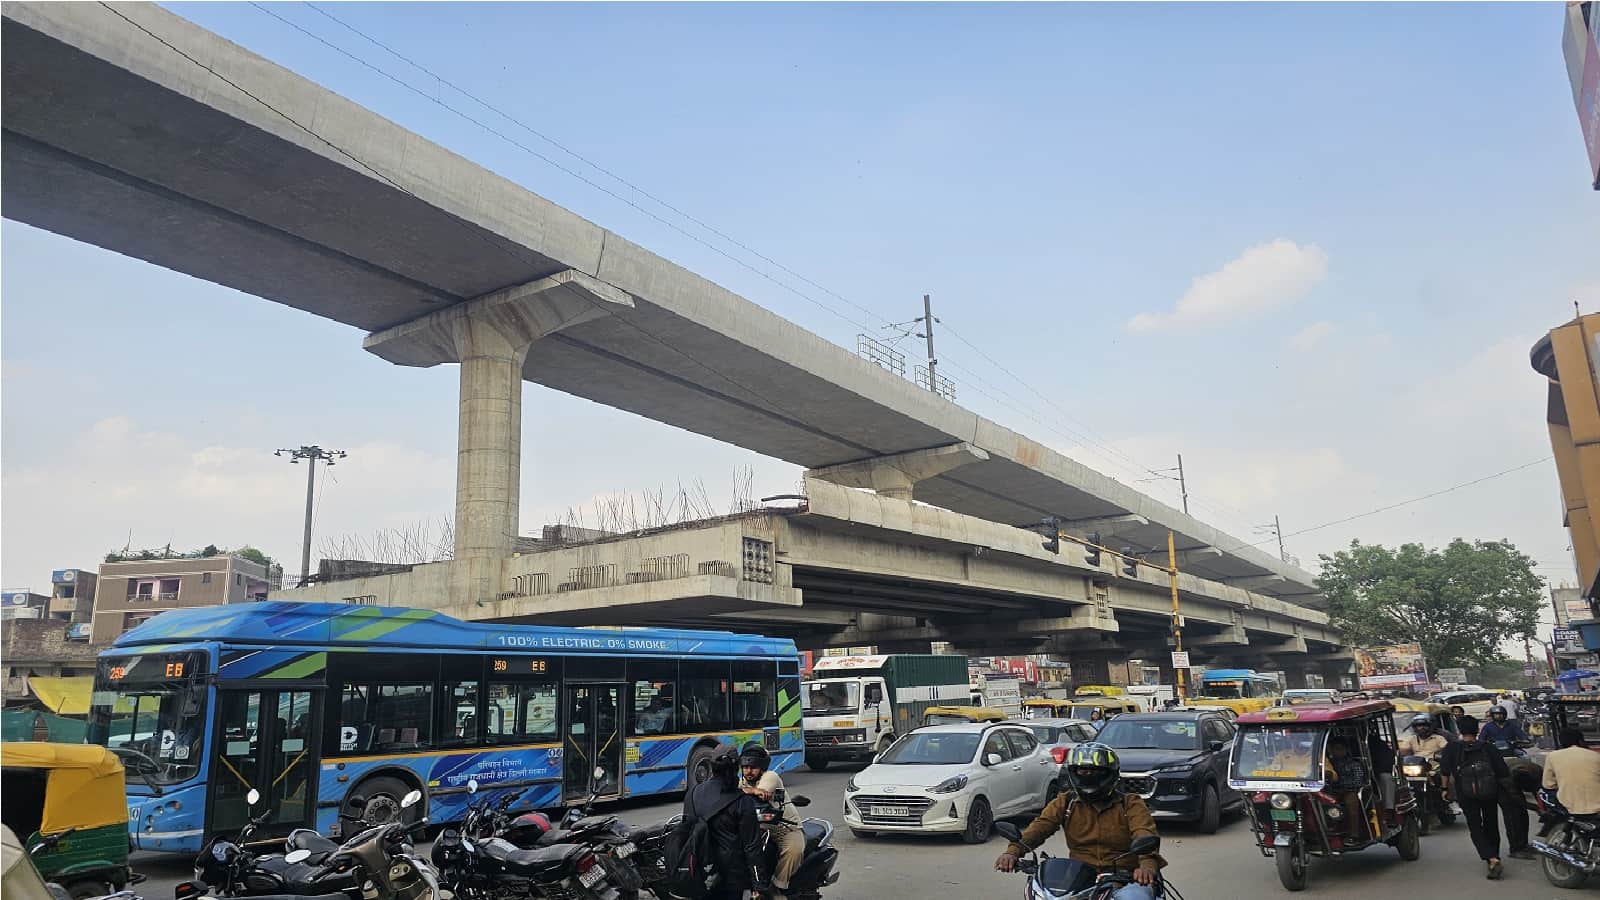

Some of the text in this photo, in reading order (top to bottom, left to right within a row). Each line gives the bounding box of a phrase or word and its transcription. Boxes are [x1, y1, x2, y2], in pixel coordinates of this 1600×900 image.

[499, 636, 669, 650] 100% ELECTRIC. 0% SMOKE.
